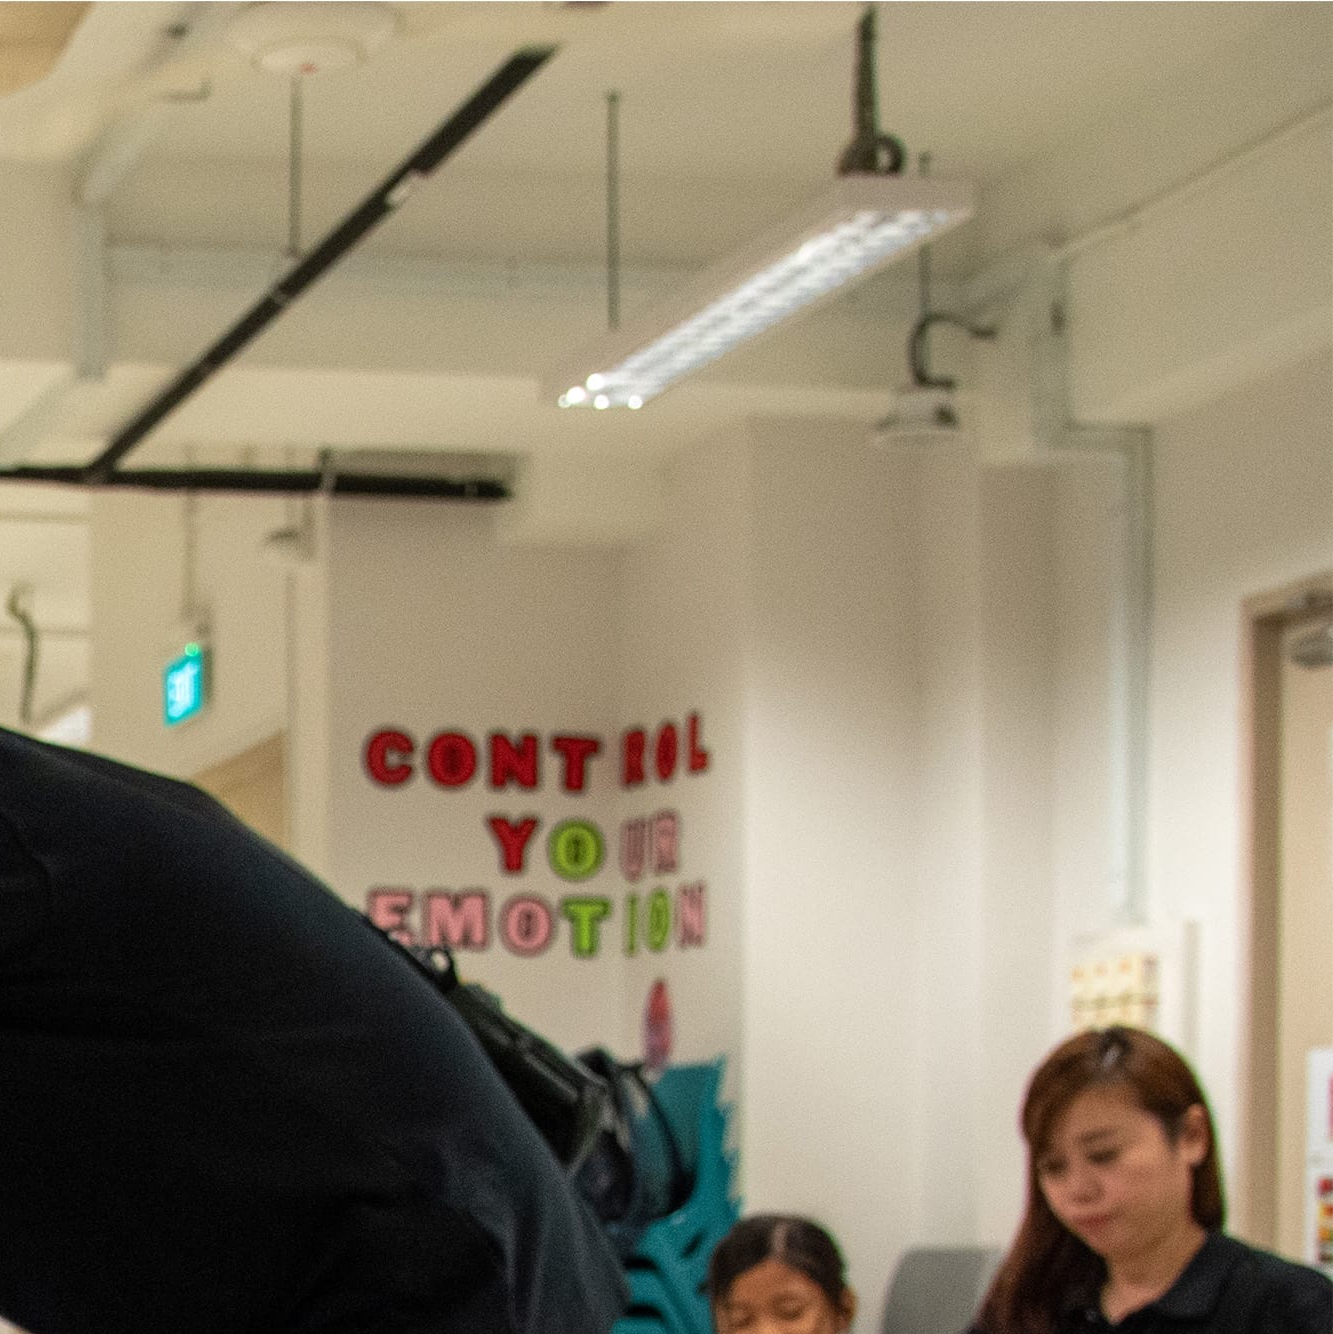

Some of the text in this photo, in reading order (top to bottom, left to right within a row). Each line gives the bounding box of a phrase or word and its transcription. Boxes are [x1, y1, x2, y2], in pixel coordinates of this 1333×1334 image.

[366, 711, 711, 791] CONTROL
[486, 808, 682, 882] YOUR
[366, 882, 708, 958] EMOTION
